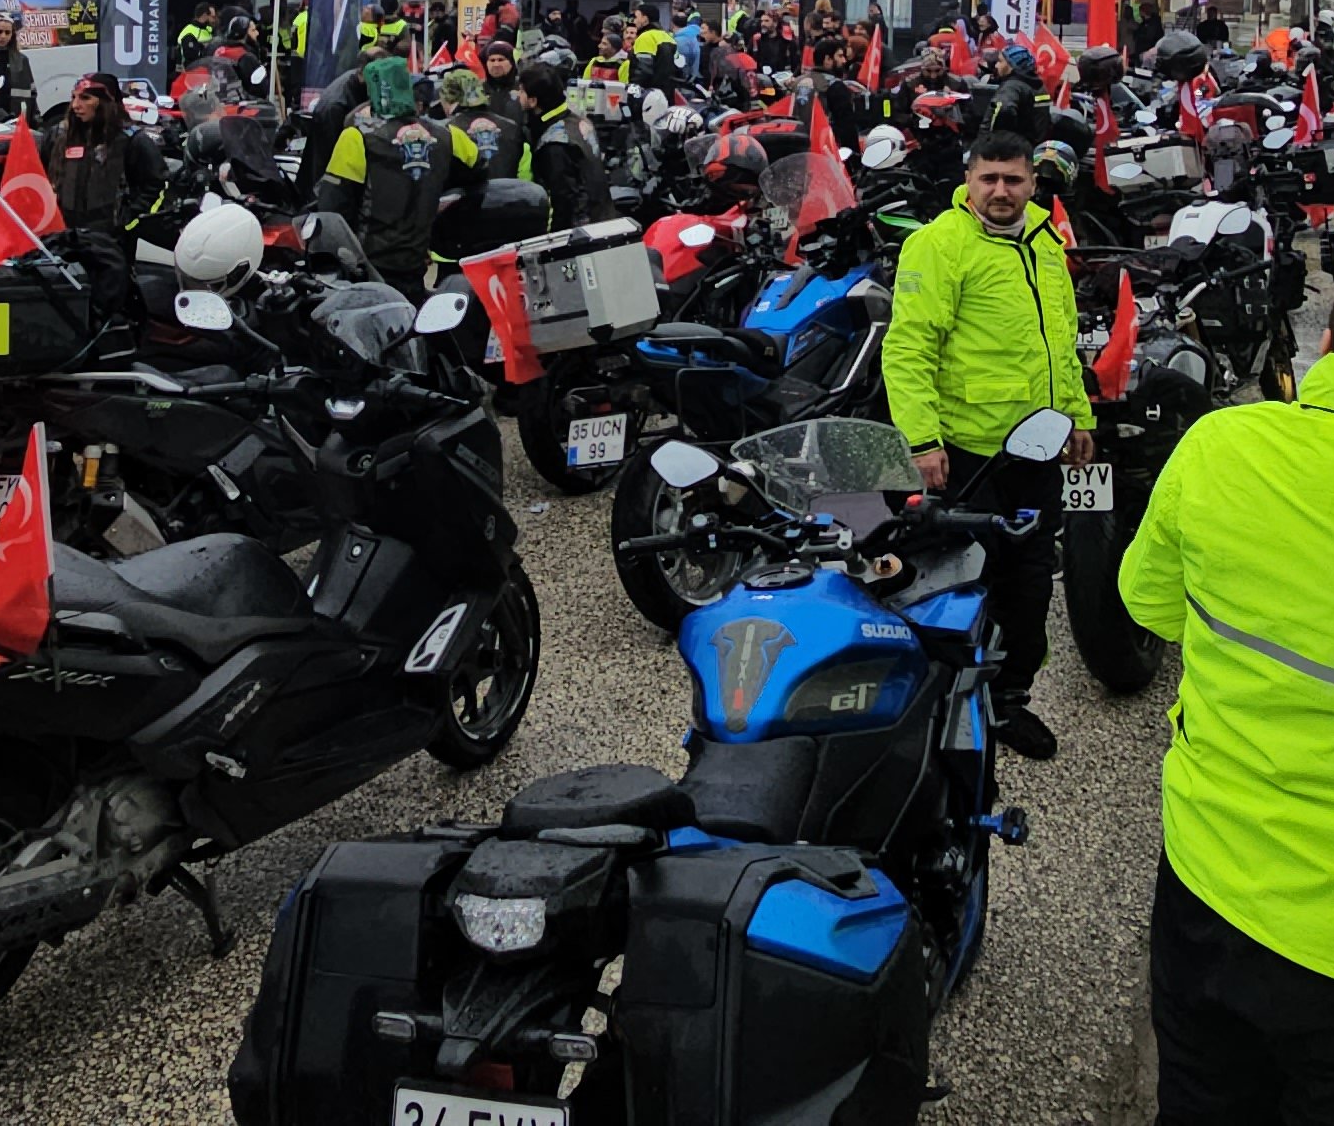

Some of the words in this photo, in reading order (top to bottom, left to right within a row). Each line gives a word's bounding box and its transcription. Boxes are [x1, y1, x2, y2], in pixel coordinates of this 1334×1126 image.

[572, 424, 590, 441] 35
[588, 441, 607, 460] 99
[1067, 465, 1110, 486] GYV
[860, 623, 913, 641] SUZUKI
[830, 682, 878, 712] GT
